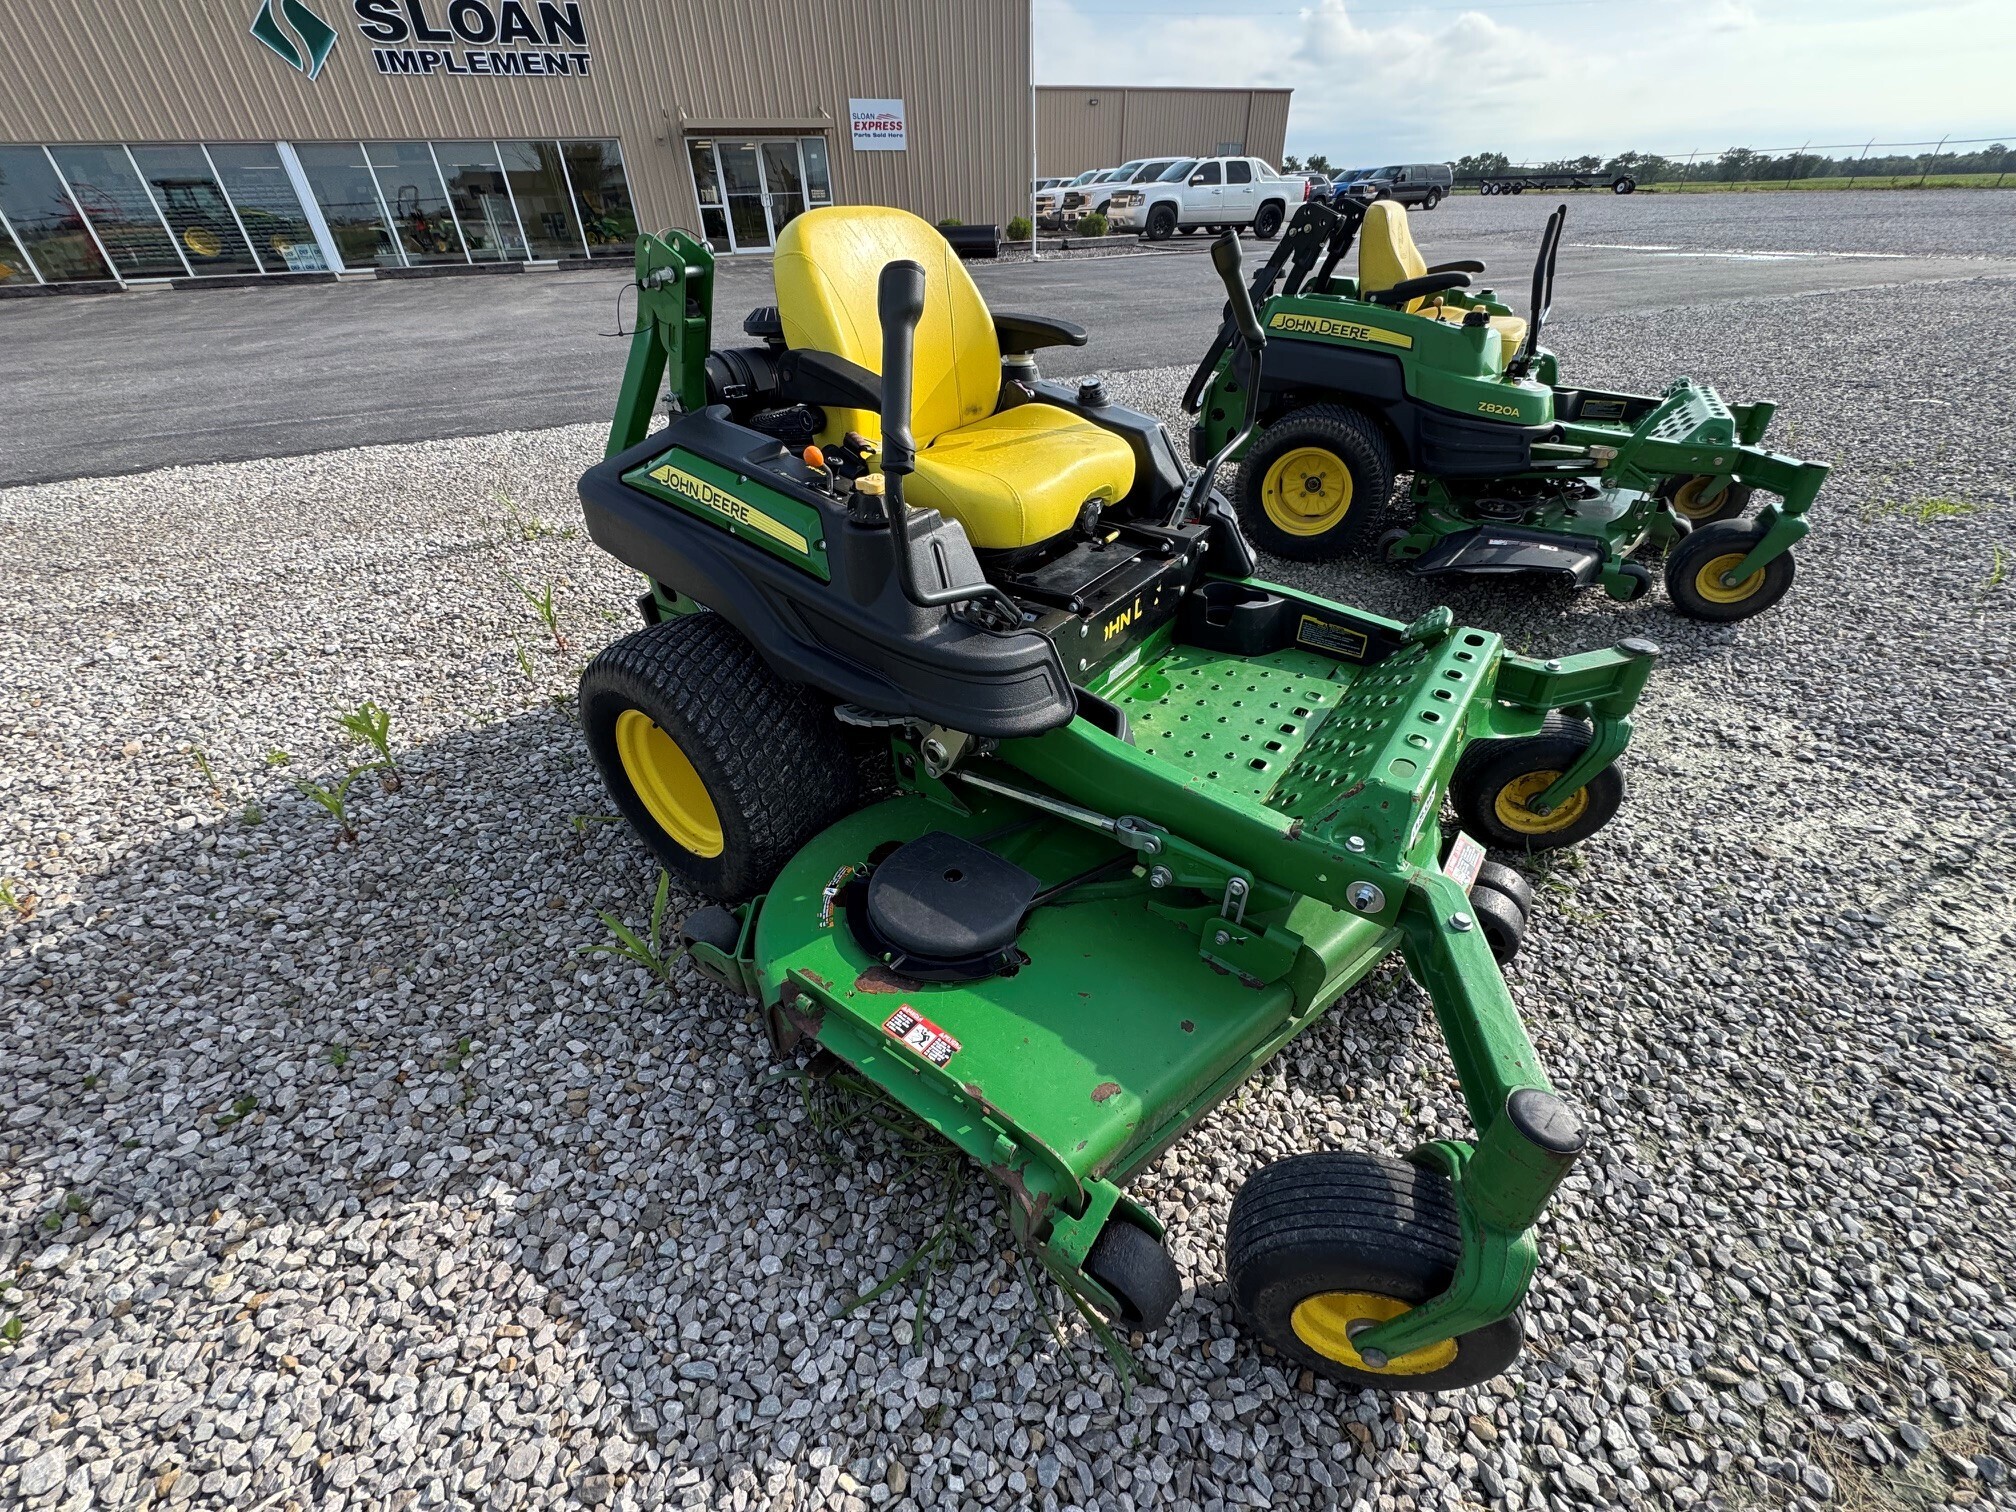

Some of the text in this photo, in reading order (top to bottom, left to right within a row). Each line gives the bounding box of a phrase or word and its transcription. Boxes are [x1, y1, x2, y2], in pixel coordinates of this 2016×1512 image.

[353, 0, 589, 47] SLOAN
[371, 47, 592, 77] IMPLEMENT
[854, 121, 903, 131] EXPRESS
[1276, 314, 1371, 341] JOHN DEERE
[1477, 401, 1521, 418] Z820A
[661, 468, 750, 525] JOHN DEERE
